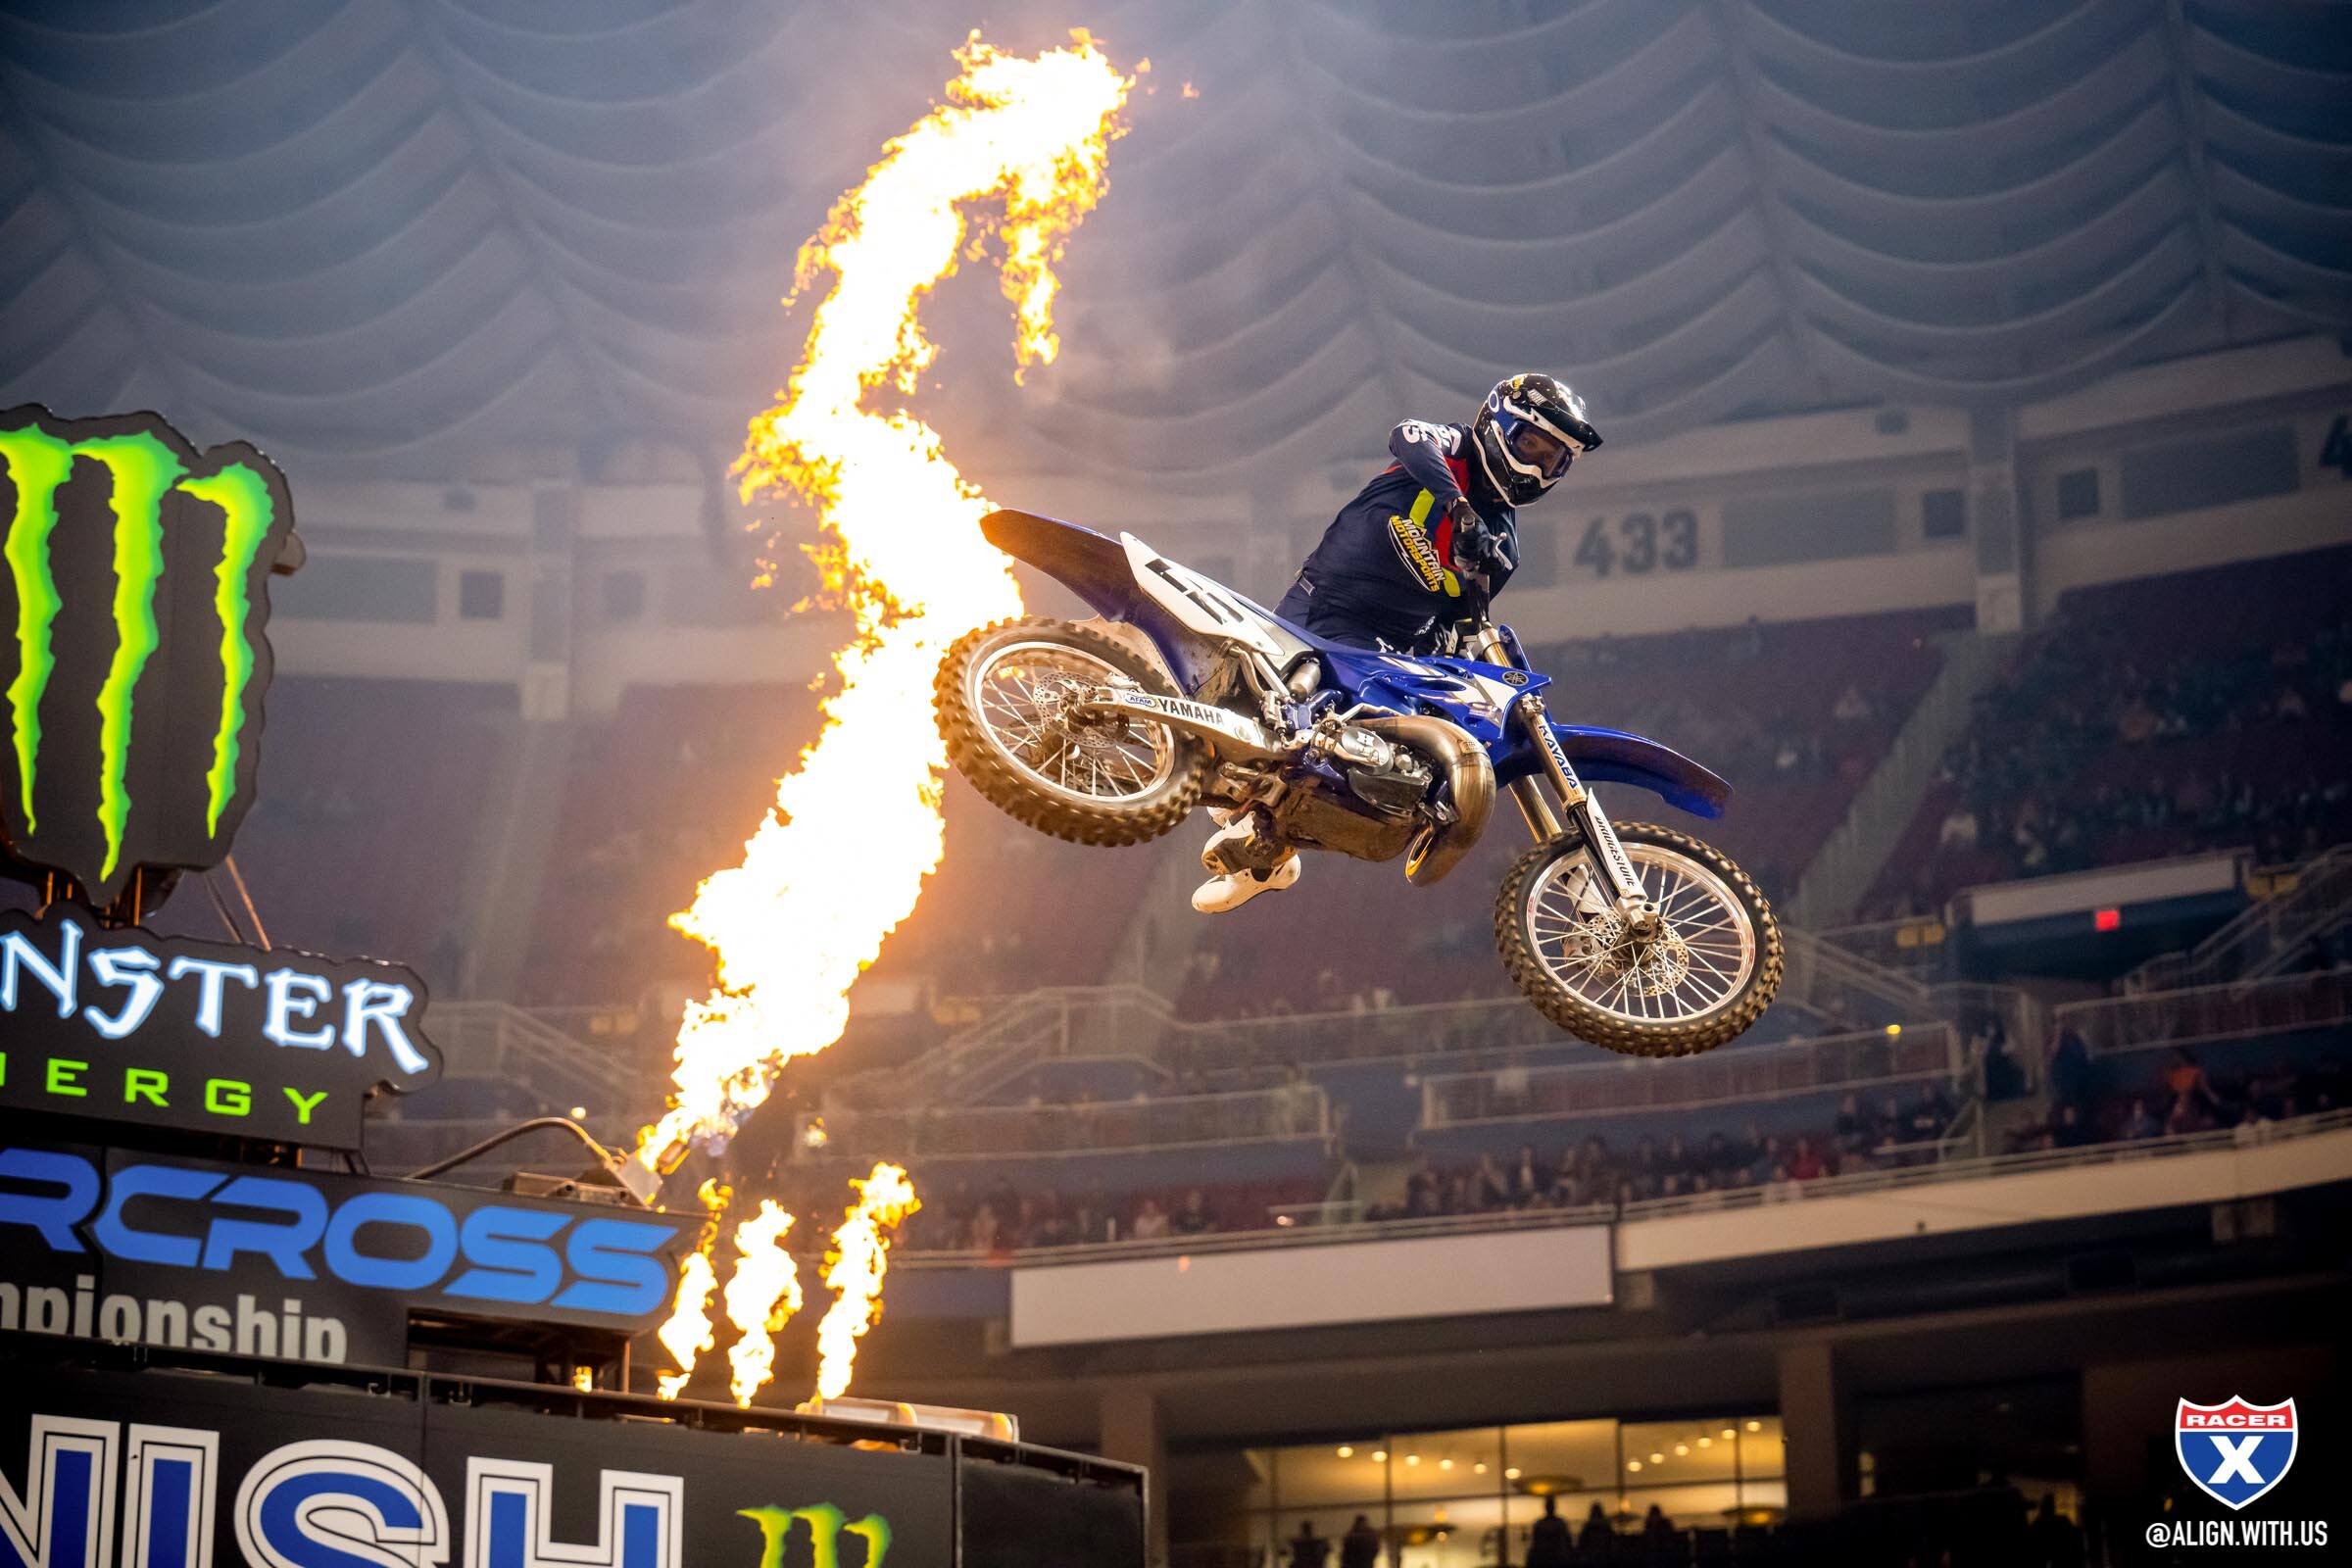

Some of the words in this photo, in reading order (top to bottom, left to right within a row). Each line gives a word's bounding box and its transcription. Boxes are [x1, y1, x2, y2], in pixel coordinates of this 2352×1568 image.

[1391, 515, 1440, 592] MOTORSPORTS
[1401, 518, 1446, 583] MOUNTAIN
[1574, 510, 1698, 579] 433
[1157, 697, 1225, 726] YAMAHA
[1539, 725, 1577, 789] KAYABA
[0, 1052, 328, 1124] ERGY
